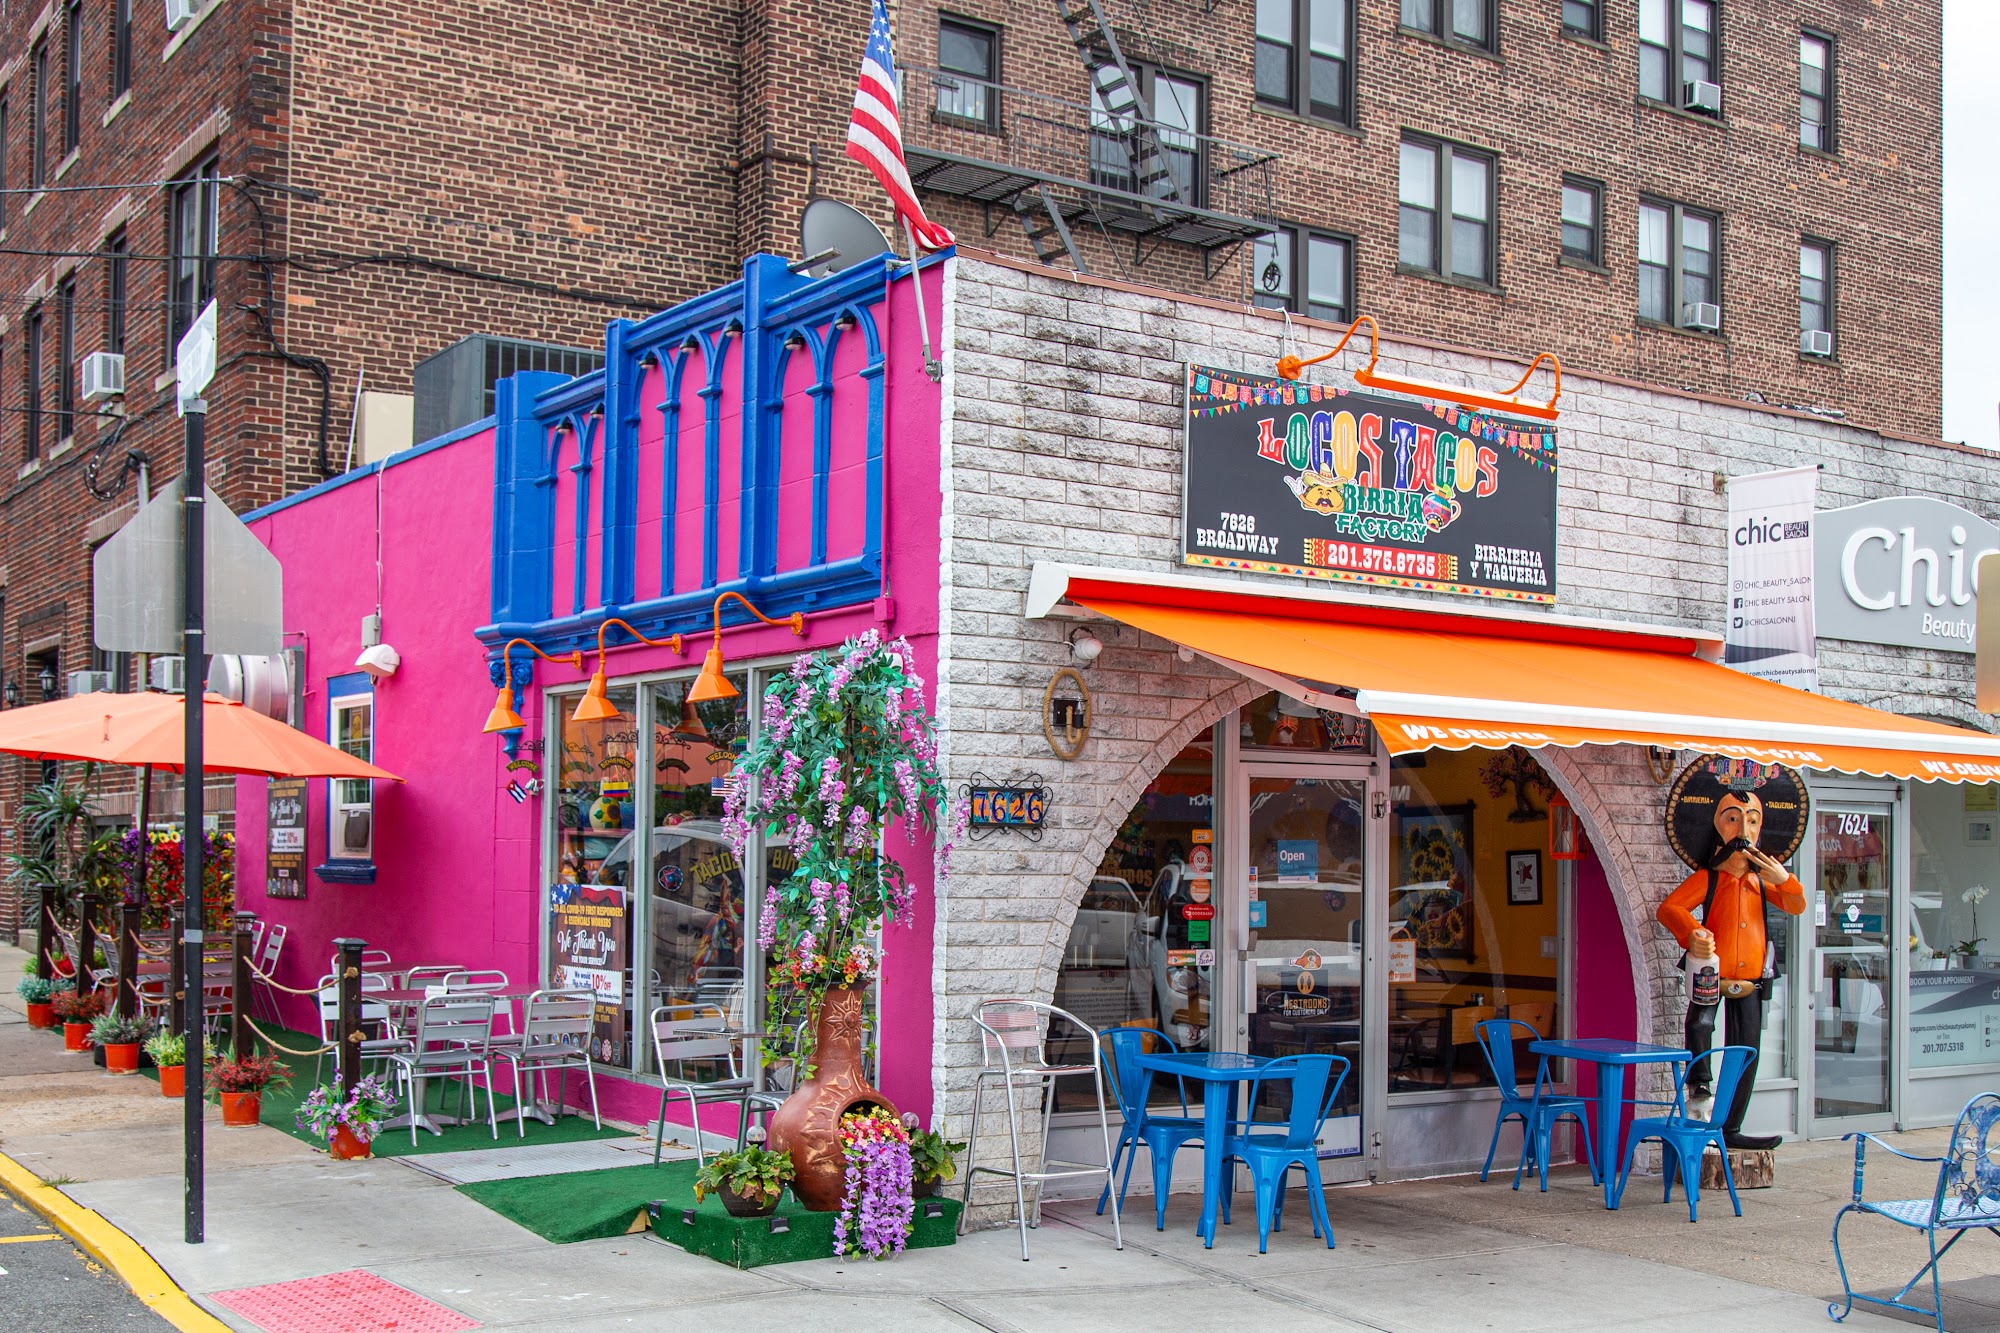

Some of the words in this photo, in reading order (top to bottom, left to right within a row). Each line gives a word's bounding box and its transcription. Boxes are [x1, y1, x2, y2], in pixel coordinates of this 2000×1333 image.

[1256, 411, 1383, 491] LOCOS
[1390, 417, 1499, 497] TACOS
[1343, 483, 1427, 524] BIRRIA
[1220, 512, 1256, 533] 7626
[1336, 514, 1428, 543] FACTORY
[1784, 522, 1808, 531] BEAUTY
[1735, 516, 1781, 546] chic
[1785, 530, 1807, 539] SALON
[1196, 527, 1279, 555] BROADWAY
[1327, 543, 1436, 577] 201.375.6735
[1474, 544, 1544, 569] BIRRIERIA
[1469, 561, 1480, 579] Y
[1482, 562, 1548, 586] TAQUERIA
[1744, 598, 1760, 607] CHIC
[1761, 597, 1786, 606] BEAUTY
[1787, 595, 1810, 604] SALON
[1744, 616, 1796, 627] @CHICSALONNJ
[1921, 612, 1976, 644] Beauty
[1400, 724, 1448, 740] WE
[601, 759, 631, 769] BIENVENIDOS
[708, 751, 737, 762] WELCOM
[509, 760, 538, 772] WELCOME
[1708, 759, 1744, 778] LOCOS
[1745, 760, 1780, 780] TACOS
[1920, 760, 1954, 774] WE
[974, 792, 1042, 822] 7626
[1768, 801, 1794, 809] TAQUERIA
[1838, 814, 1868, 835] 7624
[1280, 850, 1305, 863] Open
[557, 930, 571, 953] We
[573, 930, 596, 954] Thank
[598, 931, 616, 965] You
[592, 973, 606, 989] 10%
[1910, 977, 1926, 986] BOOK
[1927, 976, 1943, 985] YOUR
[1284, 998, 1328, 1009] RESTROOMS
[1922, 1042, 1964, 1053] 201.707.5318
